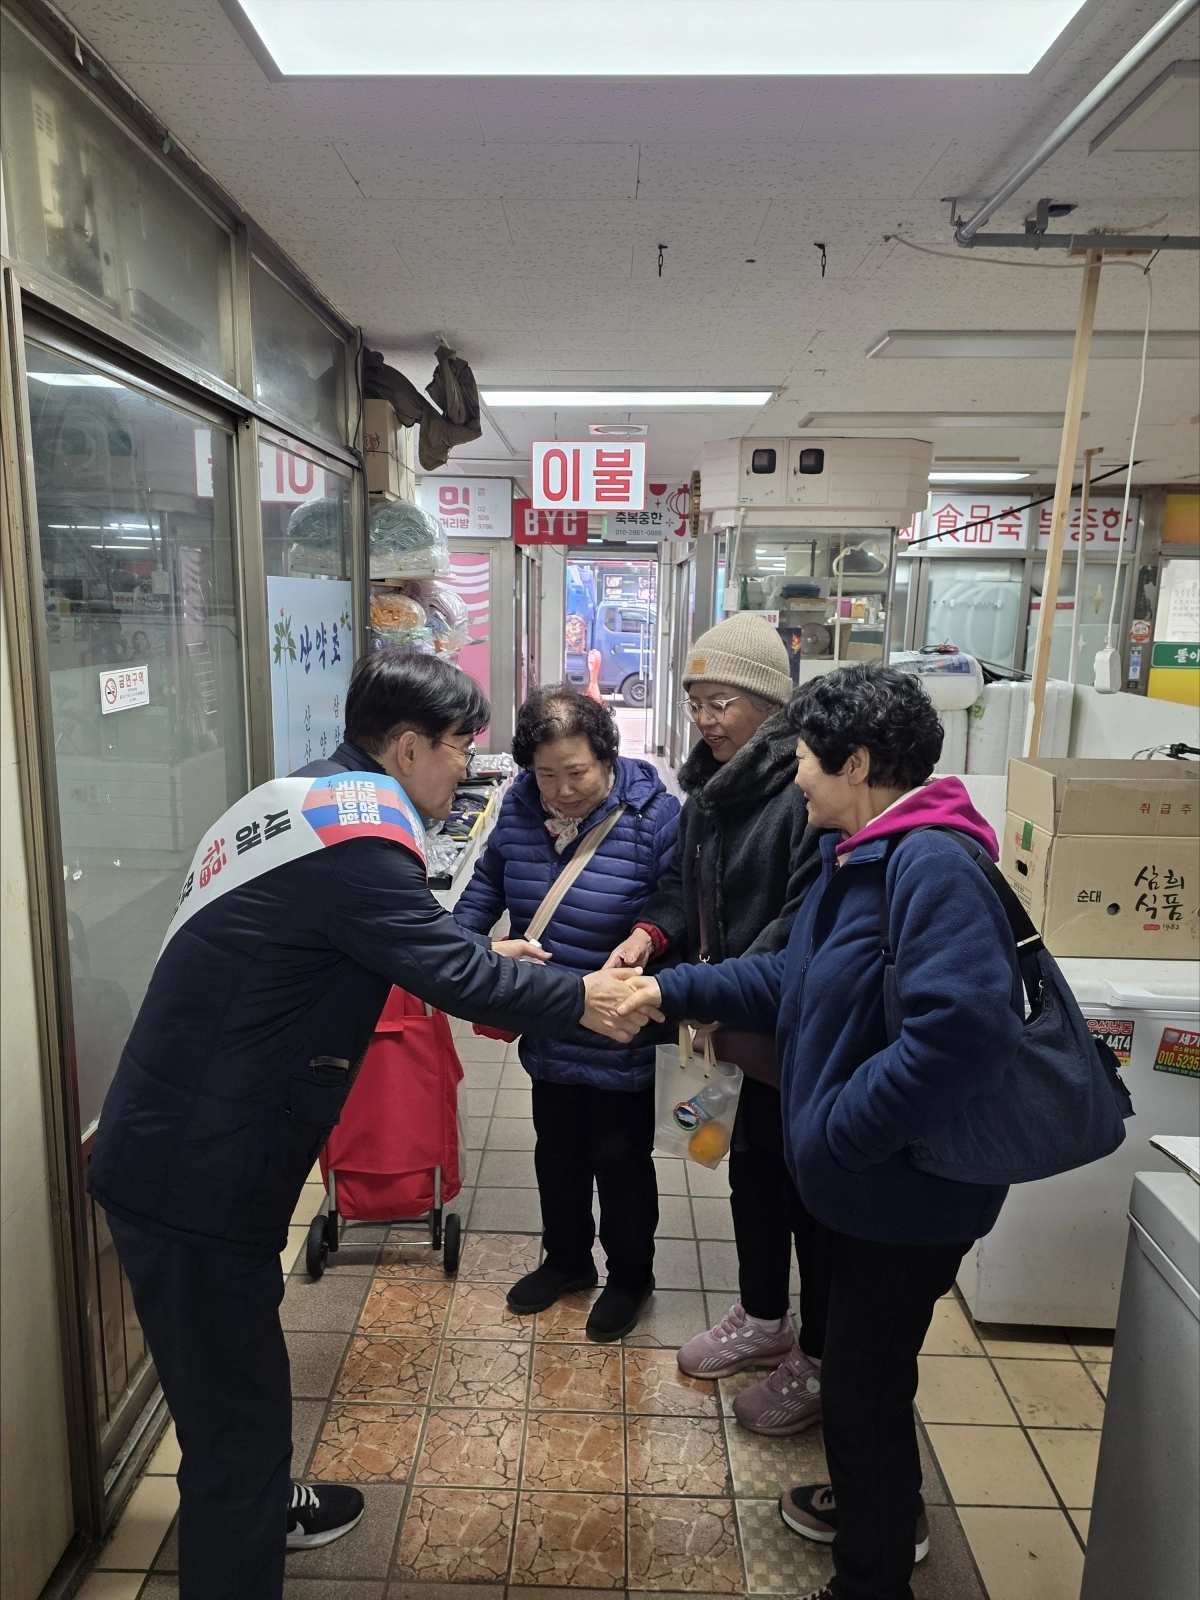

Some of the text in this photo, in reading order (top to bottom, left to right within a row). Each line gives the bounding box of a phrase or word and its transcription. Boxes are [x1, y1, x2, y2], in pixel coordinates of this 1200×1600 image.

[542, 449, 633, 502] 이불
[524, 509, 578, 536] BYC
[615, 511, 663, 525] 축복중한
[119, 671, 145, 689] 금연구역
[335, 780, 360, 827] 국민의힘
[1077, 890, 1102, 903] 순대
[1135, 893, 1184, 920] 식품
[1087, 1020, 1133, 1035] 우성냉동
